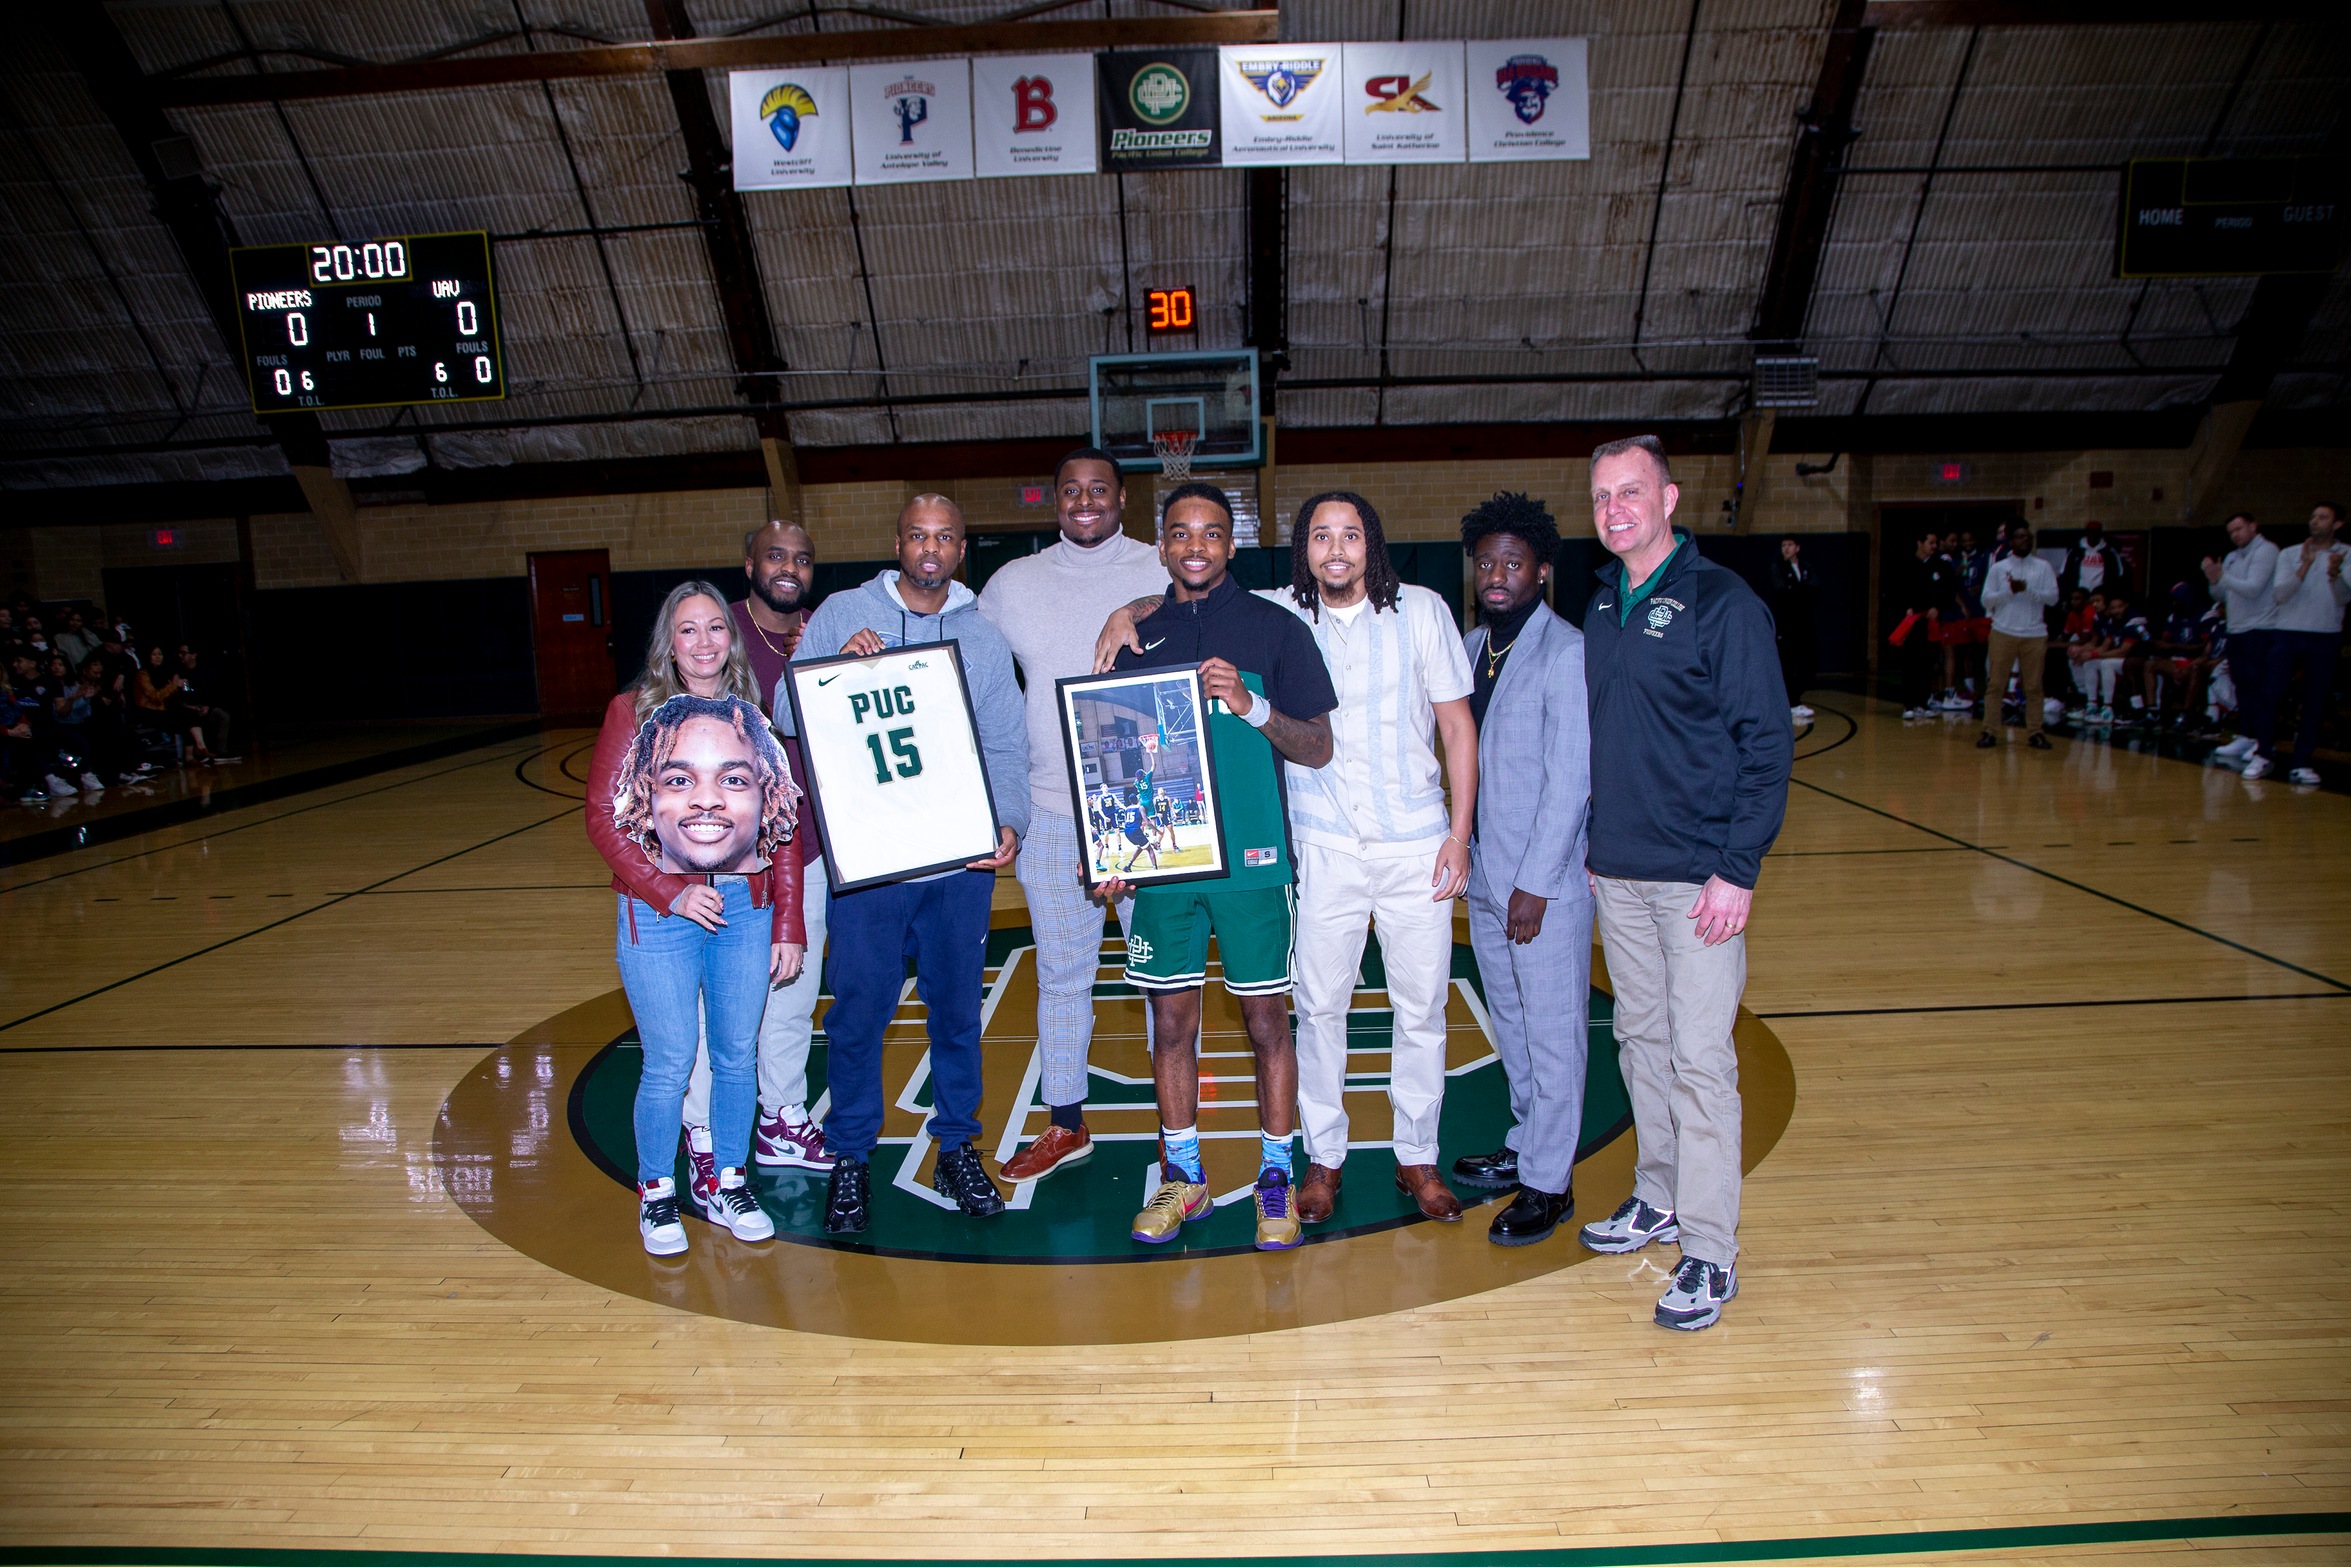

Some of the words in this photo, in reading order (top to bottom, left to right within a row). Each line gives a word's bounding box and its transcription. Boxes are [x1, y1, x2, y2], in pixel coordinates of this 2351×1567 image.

[1242, 61, 1320, 72] EMBRY-RIDDLE
[1011, 74, 1059, 134] B
[1111, 128, 1212, 150] Pioneers
[1289, 143, 1335, 152] University
[2138, 208, 2184, 226] HOME
[2283, 204, 2335, 223] GUEST
[312, 241, 407, 282] 20:00
[432, 279, 461, 299] UAV
[247, 289, 313, 311] PIONEERS
[346, 295, 382, 308] PERIOD
[1149, 290, 1192, 328] 30
[367, 312, 377, 336] 1
[456, 301, 478, 336] 0
[287, 312, 309, 347] 0
[326, 350, 351, 362] PLYR
[359, 348, 386, 361] FOUL
[397, 345, 417, 358] PTS
[456, 340, 489, 354] FOULS
[256, 354, 289, 367] FOULS
[475, 356, 493, 384] 0
[274, 368, 292, 396] 0
[301, 370, 315, 391] 6
[434, 362, 448, 383] 6
[848, 685, 916, 724] PUC
[865, 725, 926, 787] 15
[1126, 811, 1136, 823] 15
[1264, 850, 1271, 858] S
